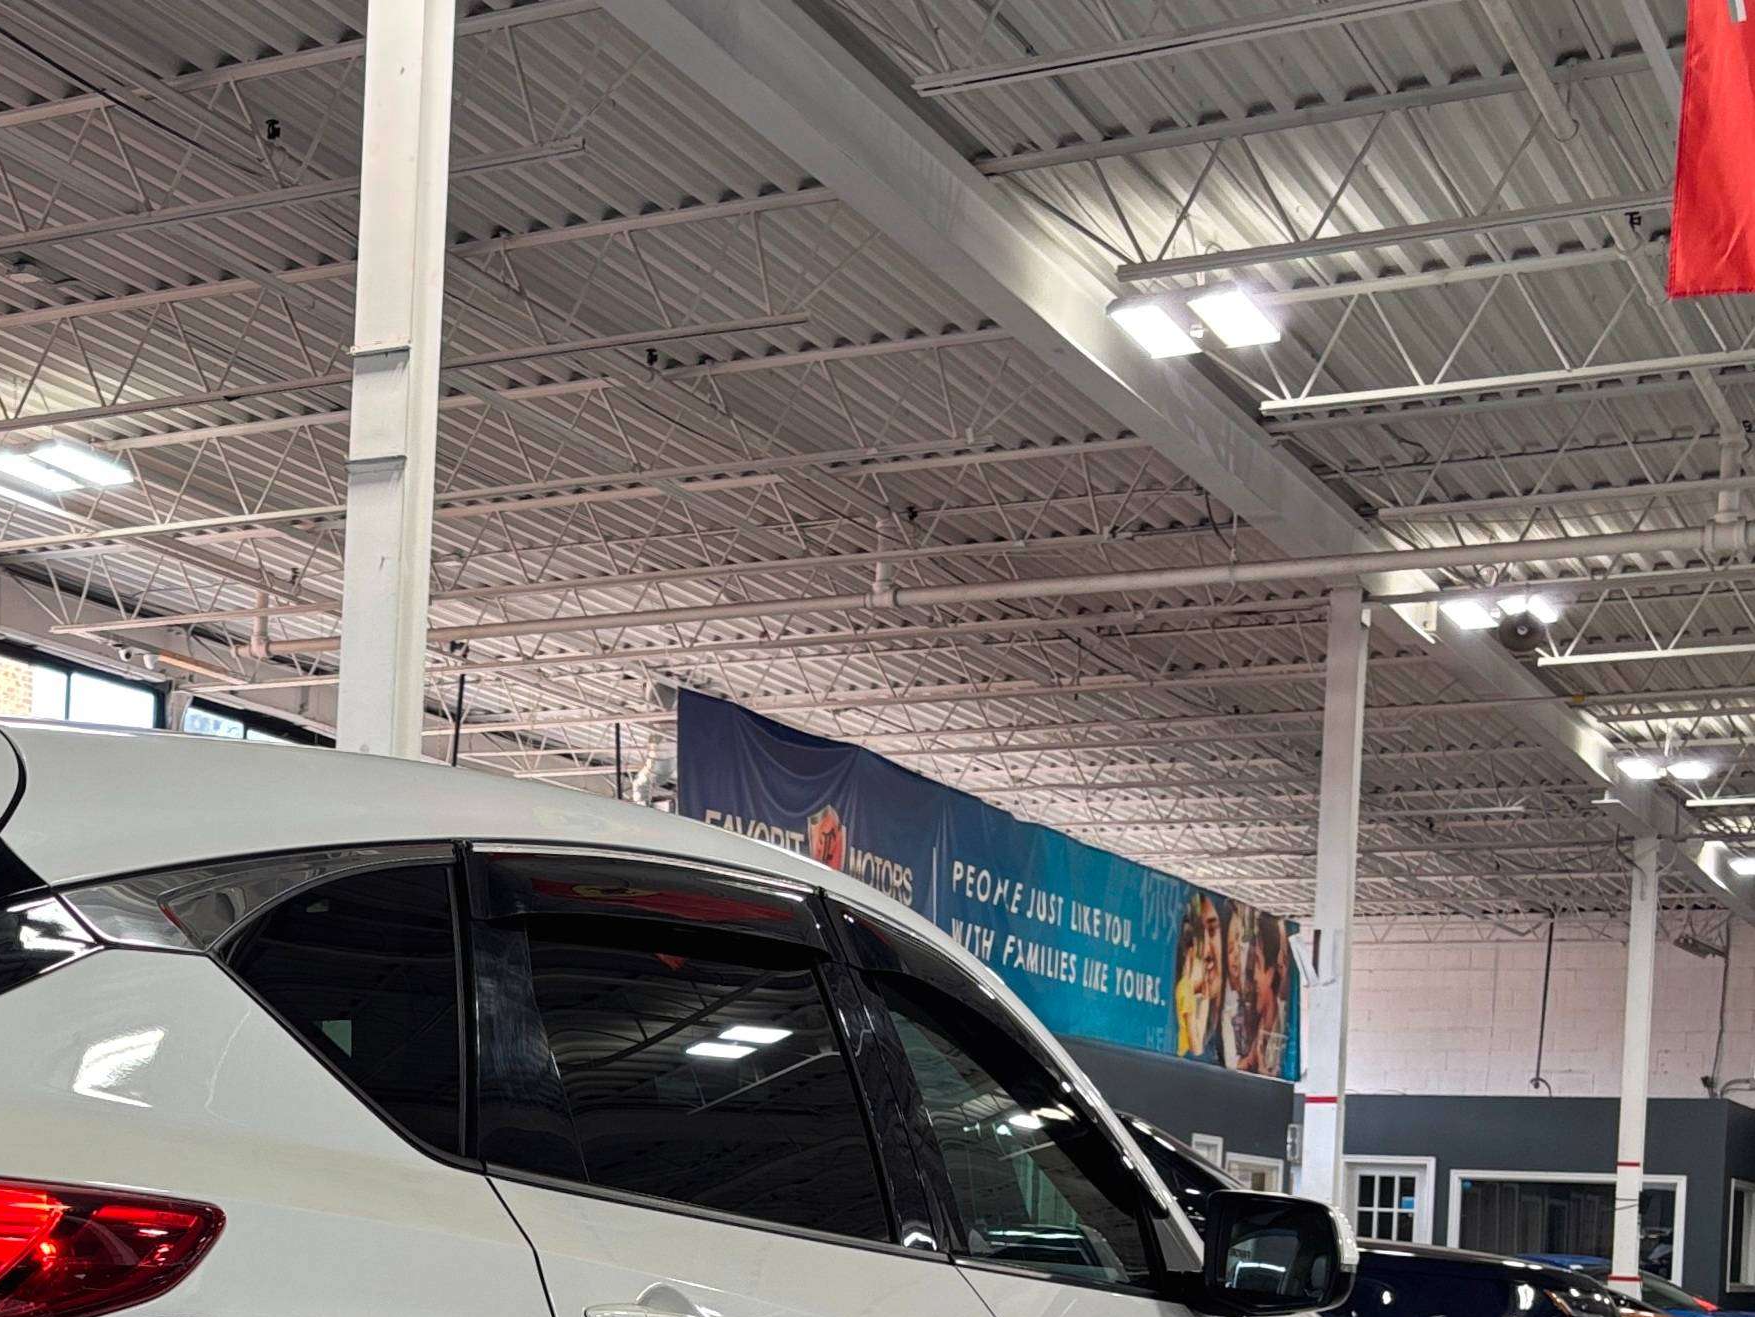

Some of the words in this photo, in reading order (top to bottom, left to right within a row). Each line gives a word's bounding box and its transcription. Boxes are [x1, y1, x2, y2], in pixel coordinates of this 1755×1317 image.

[849, 846, 913, 906] MOTORS
[1026, 888, 1064, 927] JUST
[1070, 901, 1101, 939] LIKE
[1104, 912, 1137, 953] YOU,
[951, 918, 995, 962] WITH
[1002, 935, 1077, 985] FAMILIES
[1082, 957, 1109, 993] LIKE
[1115, 967, 1166, 1006] YOURS.
